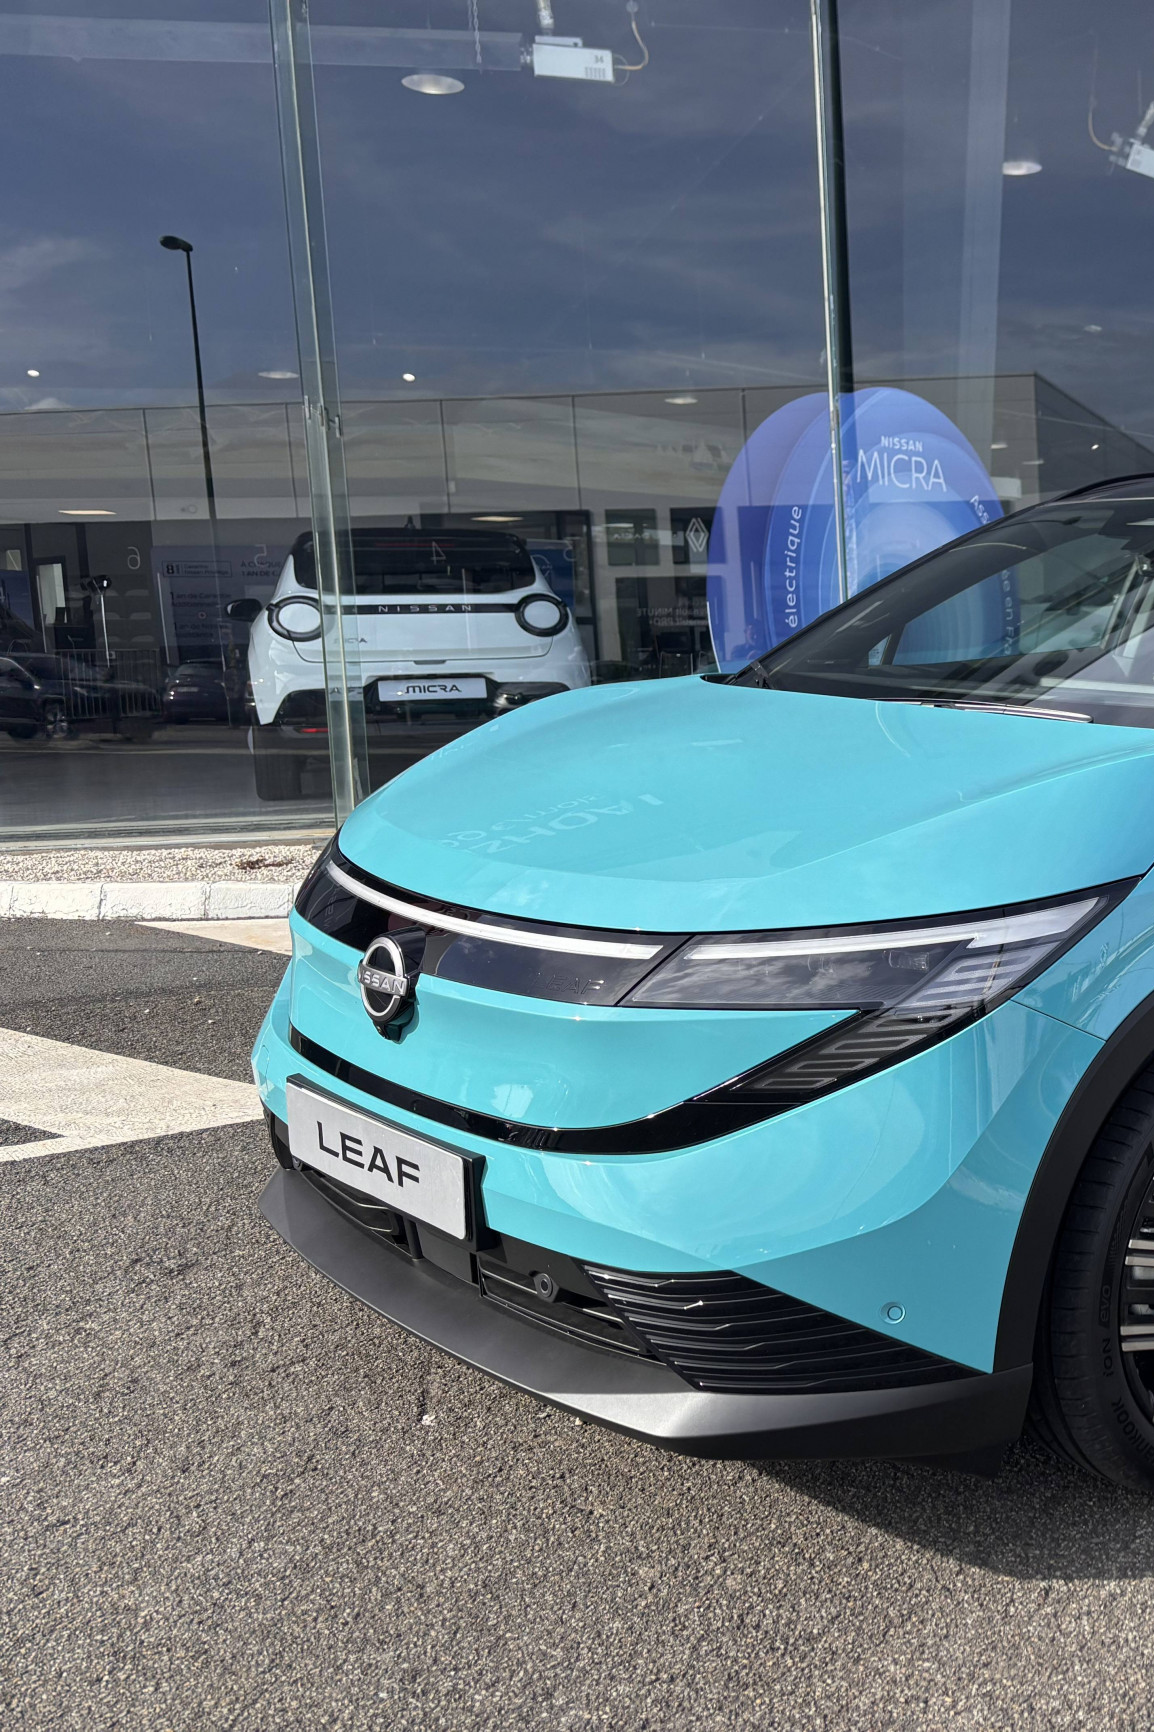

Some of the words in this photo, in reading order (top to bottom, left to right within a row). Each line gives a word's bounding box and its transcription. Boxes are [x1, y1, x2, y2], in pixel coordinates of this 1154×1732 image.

[880, 436, 923, 452] NISSAN
[856, 447, 947, 492] MICRA
[784, 505, 802, 629] électrique
[378, 605, 472, 613] NISSAN
[404, 684, 463, 694] MICRA
[359, 970, 405, 995] ISSAN
[317, 1119, 420, 1189] LEAF
